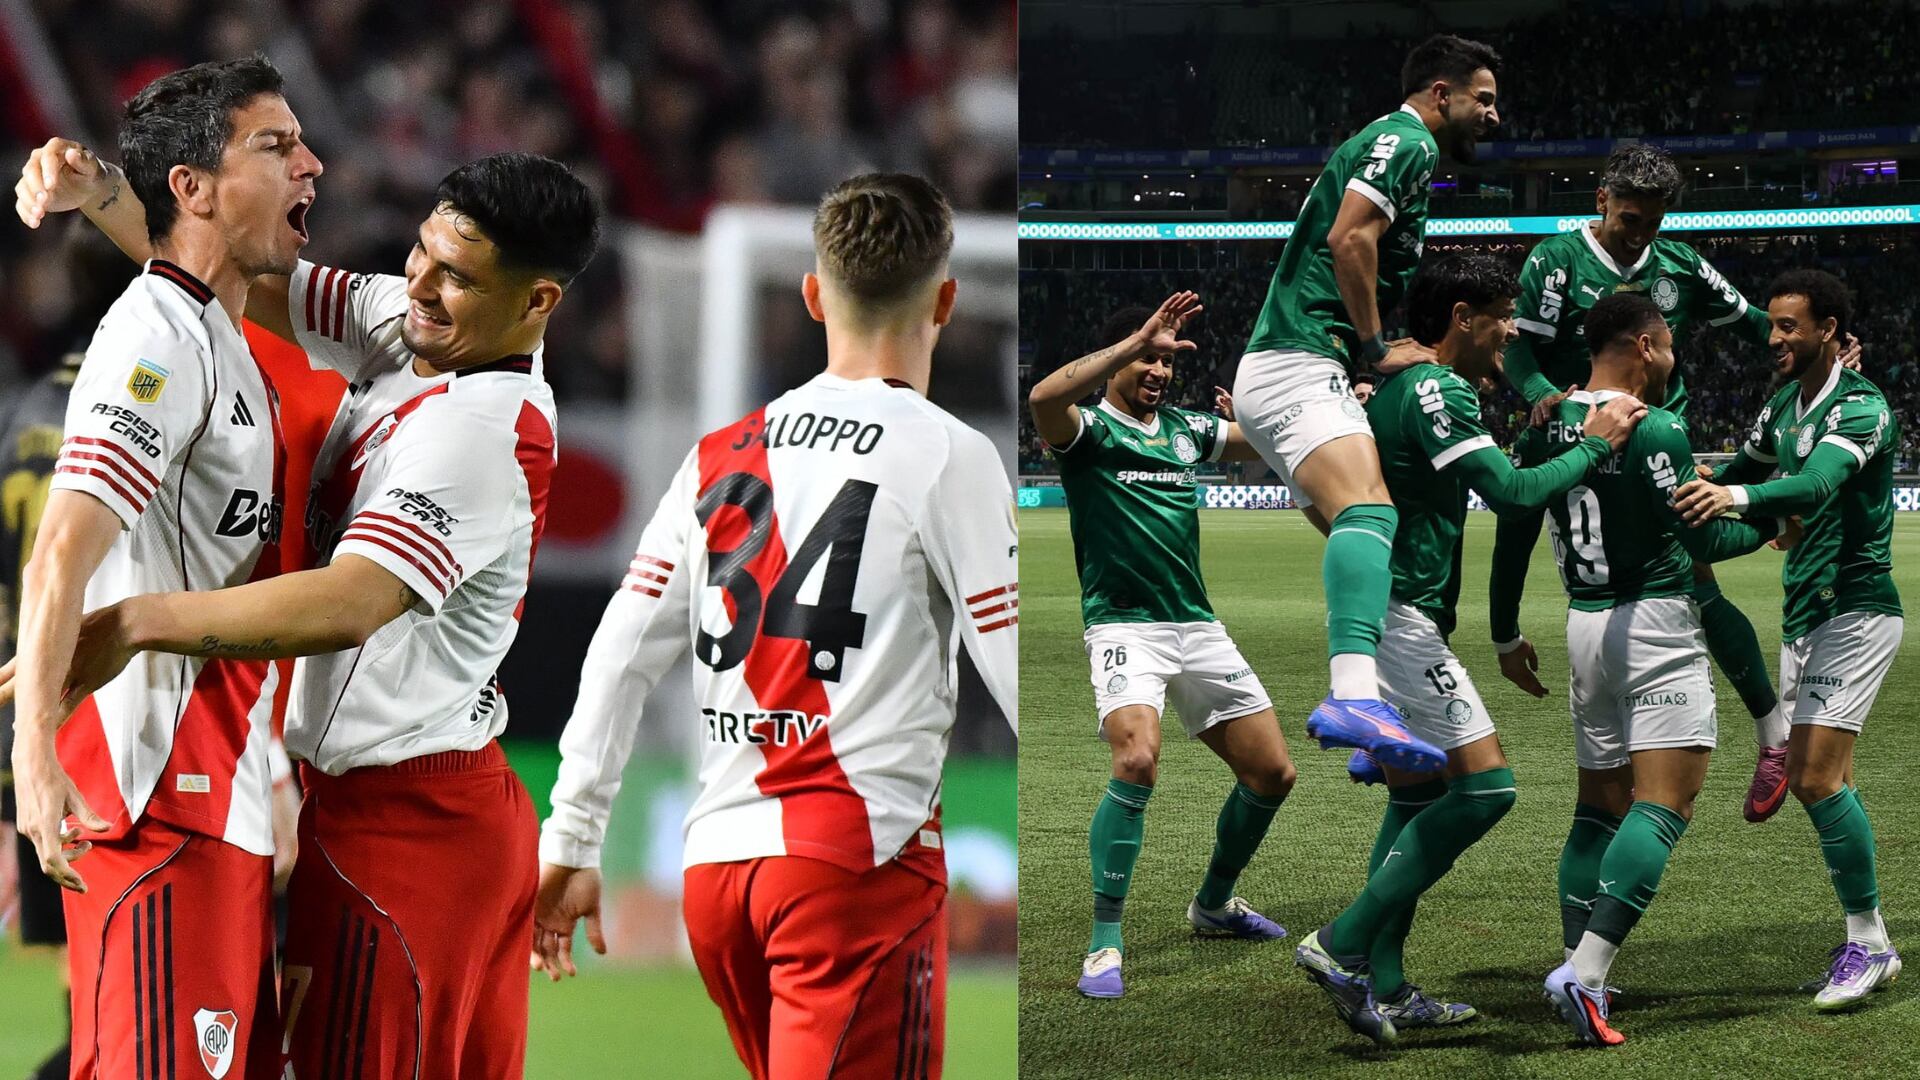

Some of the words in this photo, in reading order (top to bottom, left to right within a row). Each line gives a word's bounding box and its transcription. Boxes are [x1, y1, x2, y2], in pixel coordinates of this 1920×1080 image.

[91, 403, 162, 440] ASSIST
[109, 421, 161, 458] CARD
[1249, 500, 1290, 509] SPORTS
[1567, 485, 1609, 585] 9
[694, 472, 878, 683] 34
[1103, 645, 1127, 672] 26
[1424, 662, 1457, 695] 15
[204, 1024, 228, 1056] CARP
